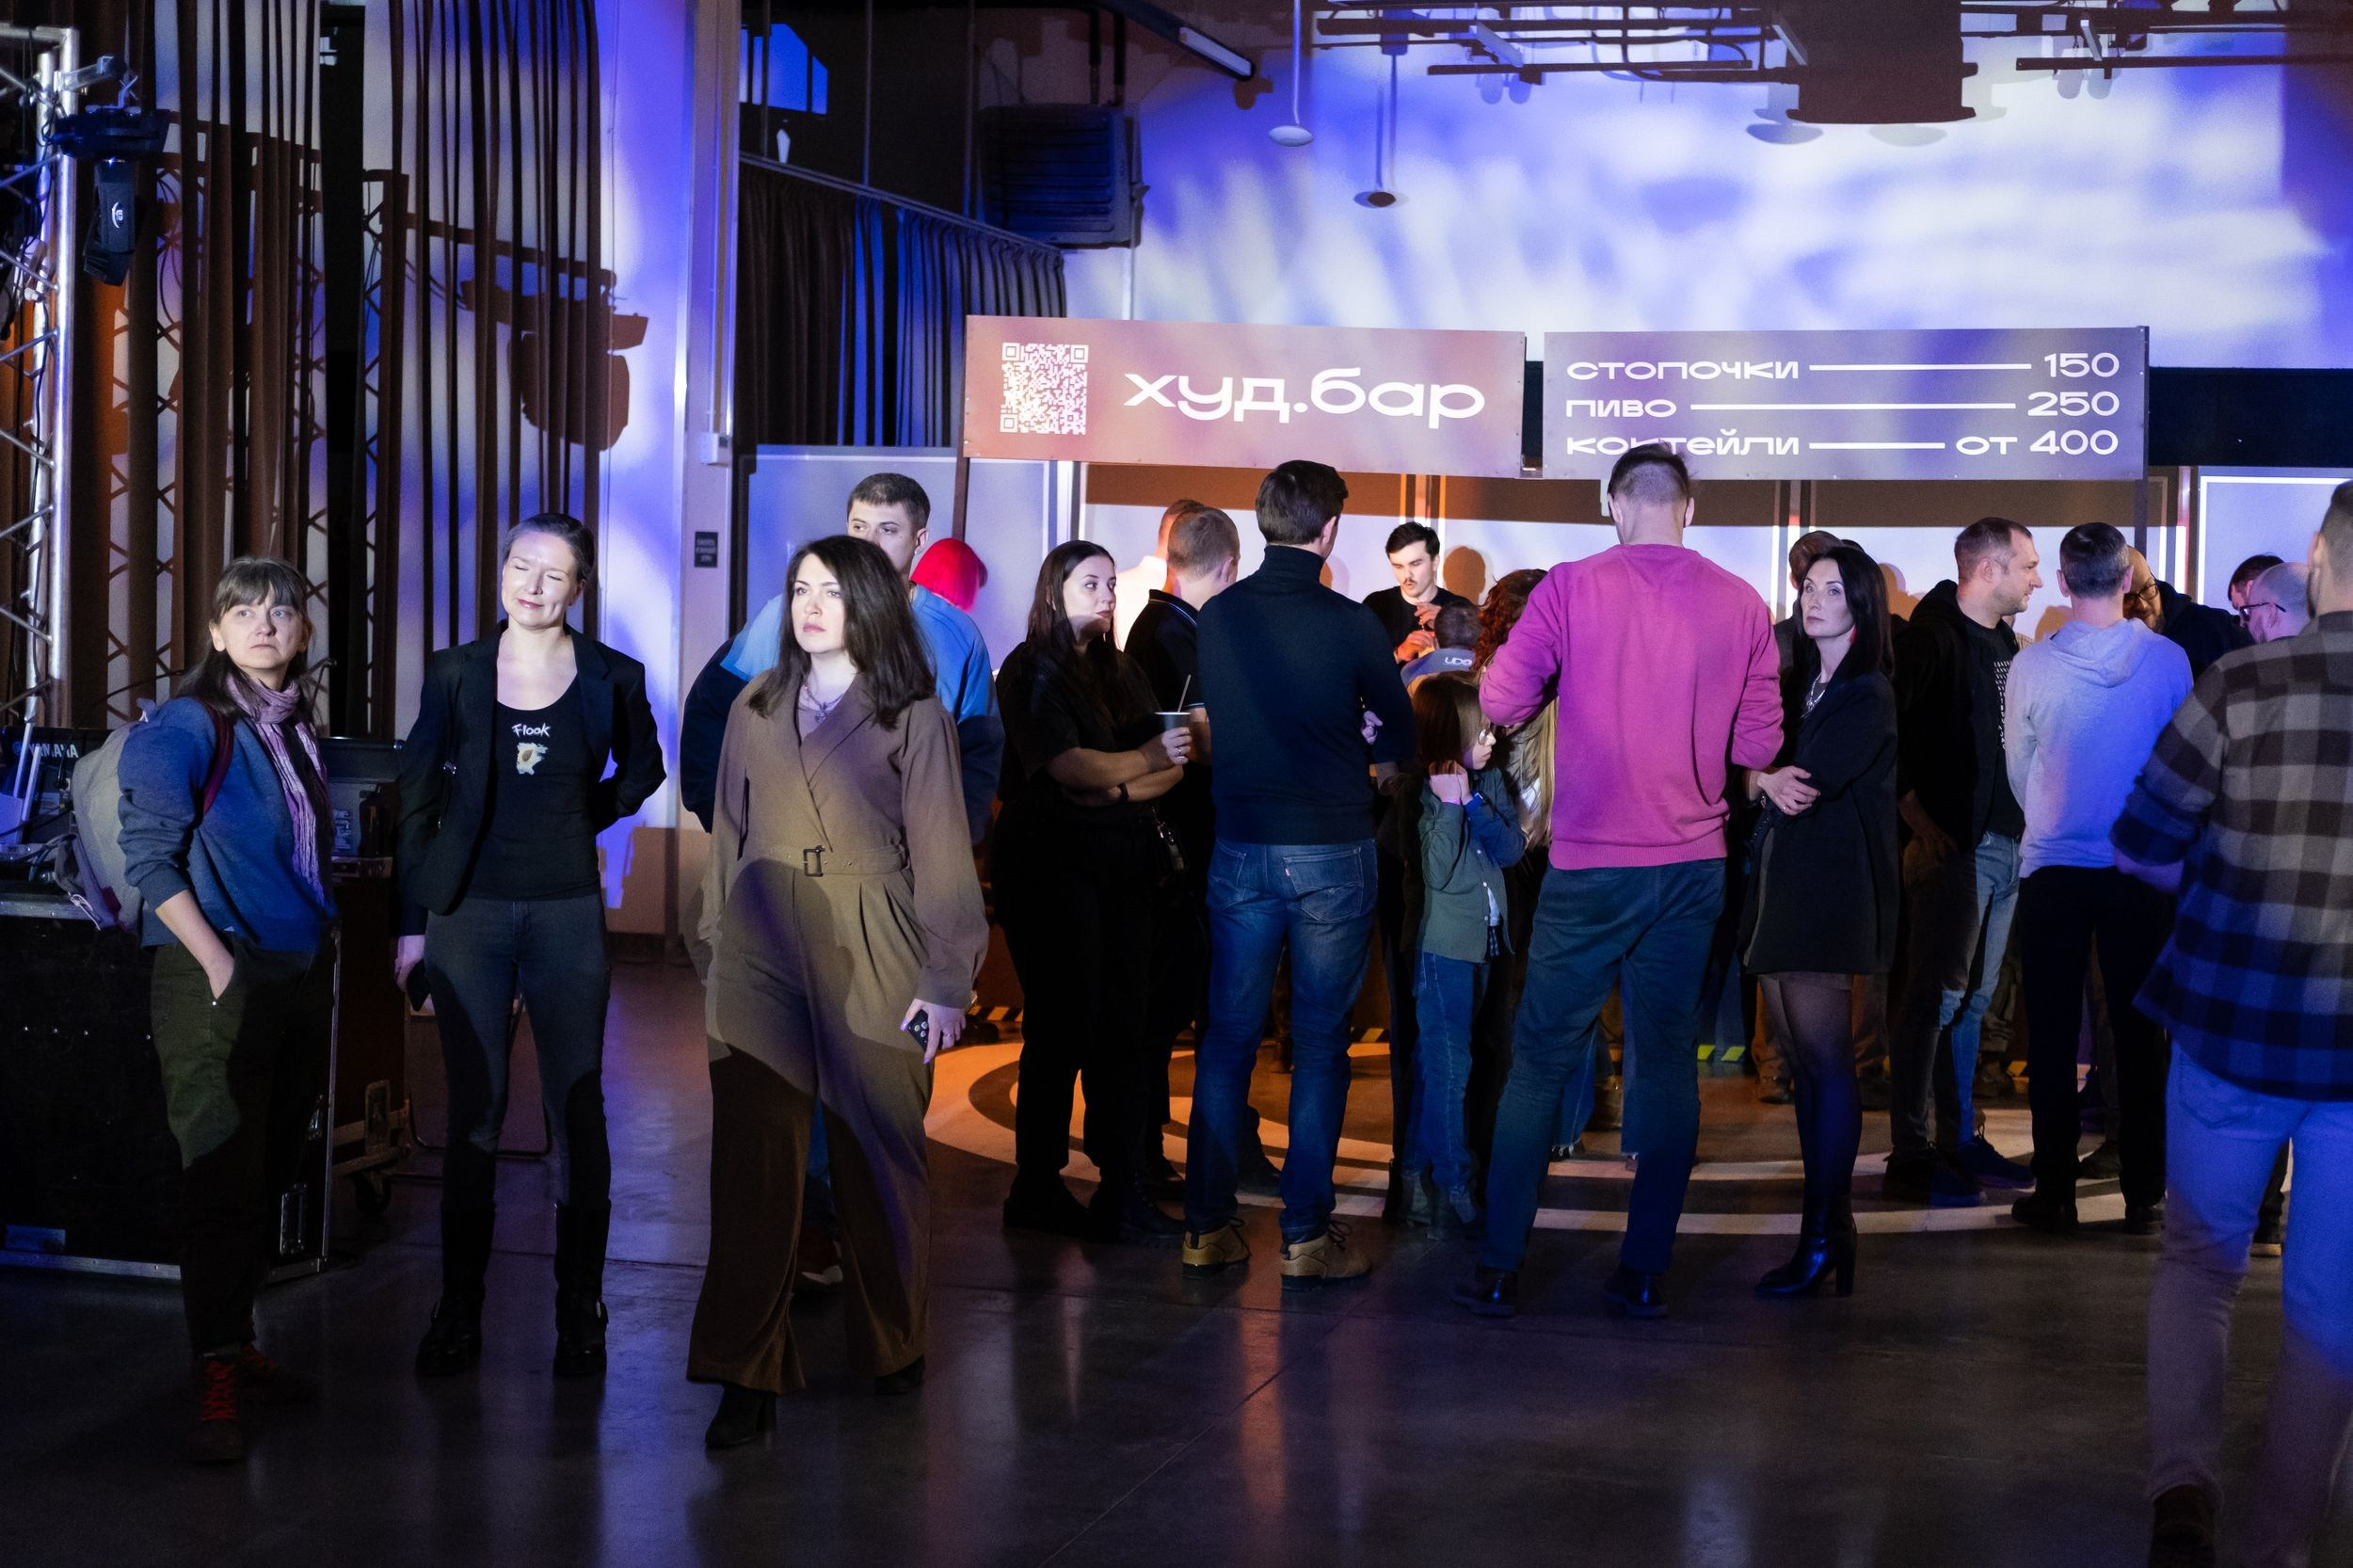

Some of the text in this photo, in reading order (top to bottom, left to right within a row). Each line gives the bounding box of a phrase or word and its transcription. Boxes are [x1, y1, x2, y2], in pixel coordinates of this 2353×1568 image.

[2044, 352, 2120, 377] 150
[1124, 367, 1485, 429] худ.бар
[2027, 391, 2120, 416] 250
[2029, 429, 2119, 456] 400
[511, 722, 551, 738] Flook
